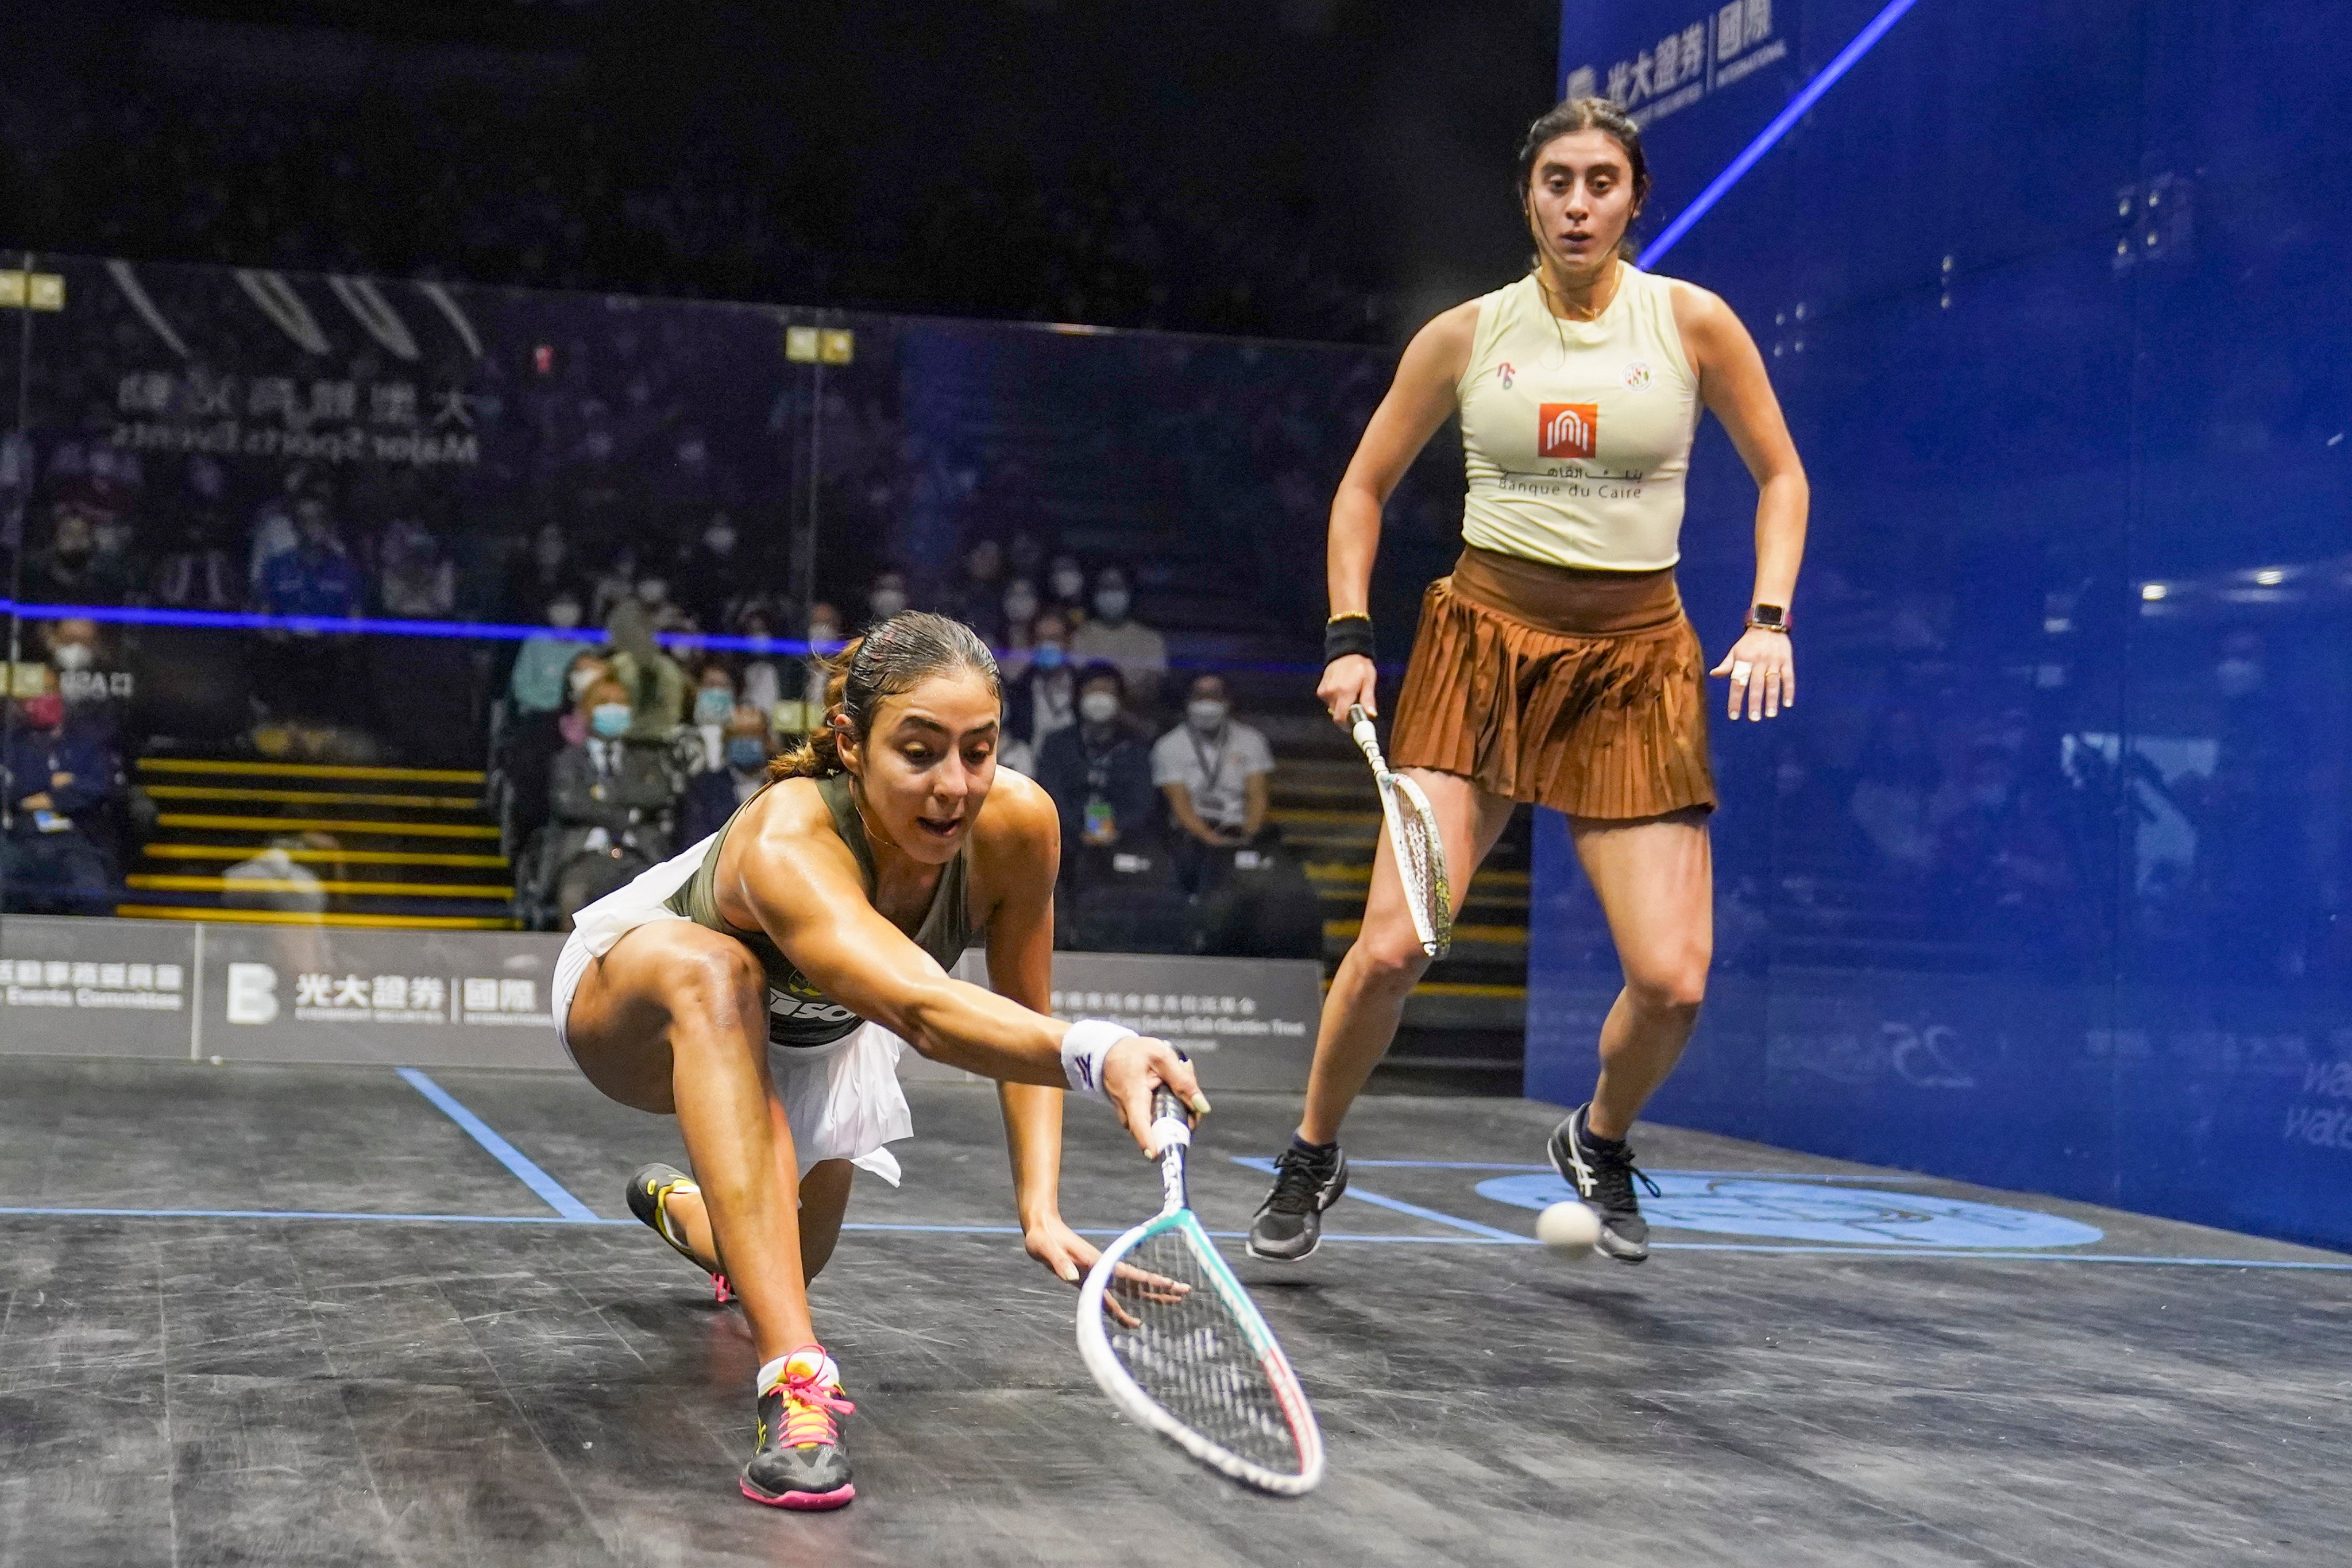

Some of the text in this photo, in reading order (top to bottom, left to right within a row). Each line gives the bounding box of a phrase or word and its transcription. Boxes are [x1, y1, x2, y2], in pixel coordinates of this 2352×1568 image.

[1499, 477, 1642, 499] Banque du Caire
